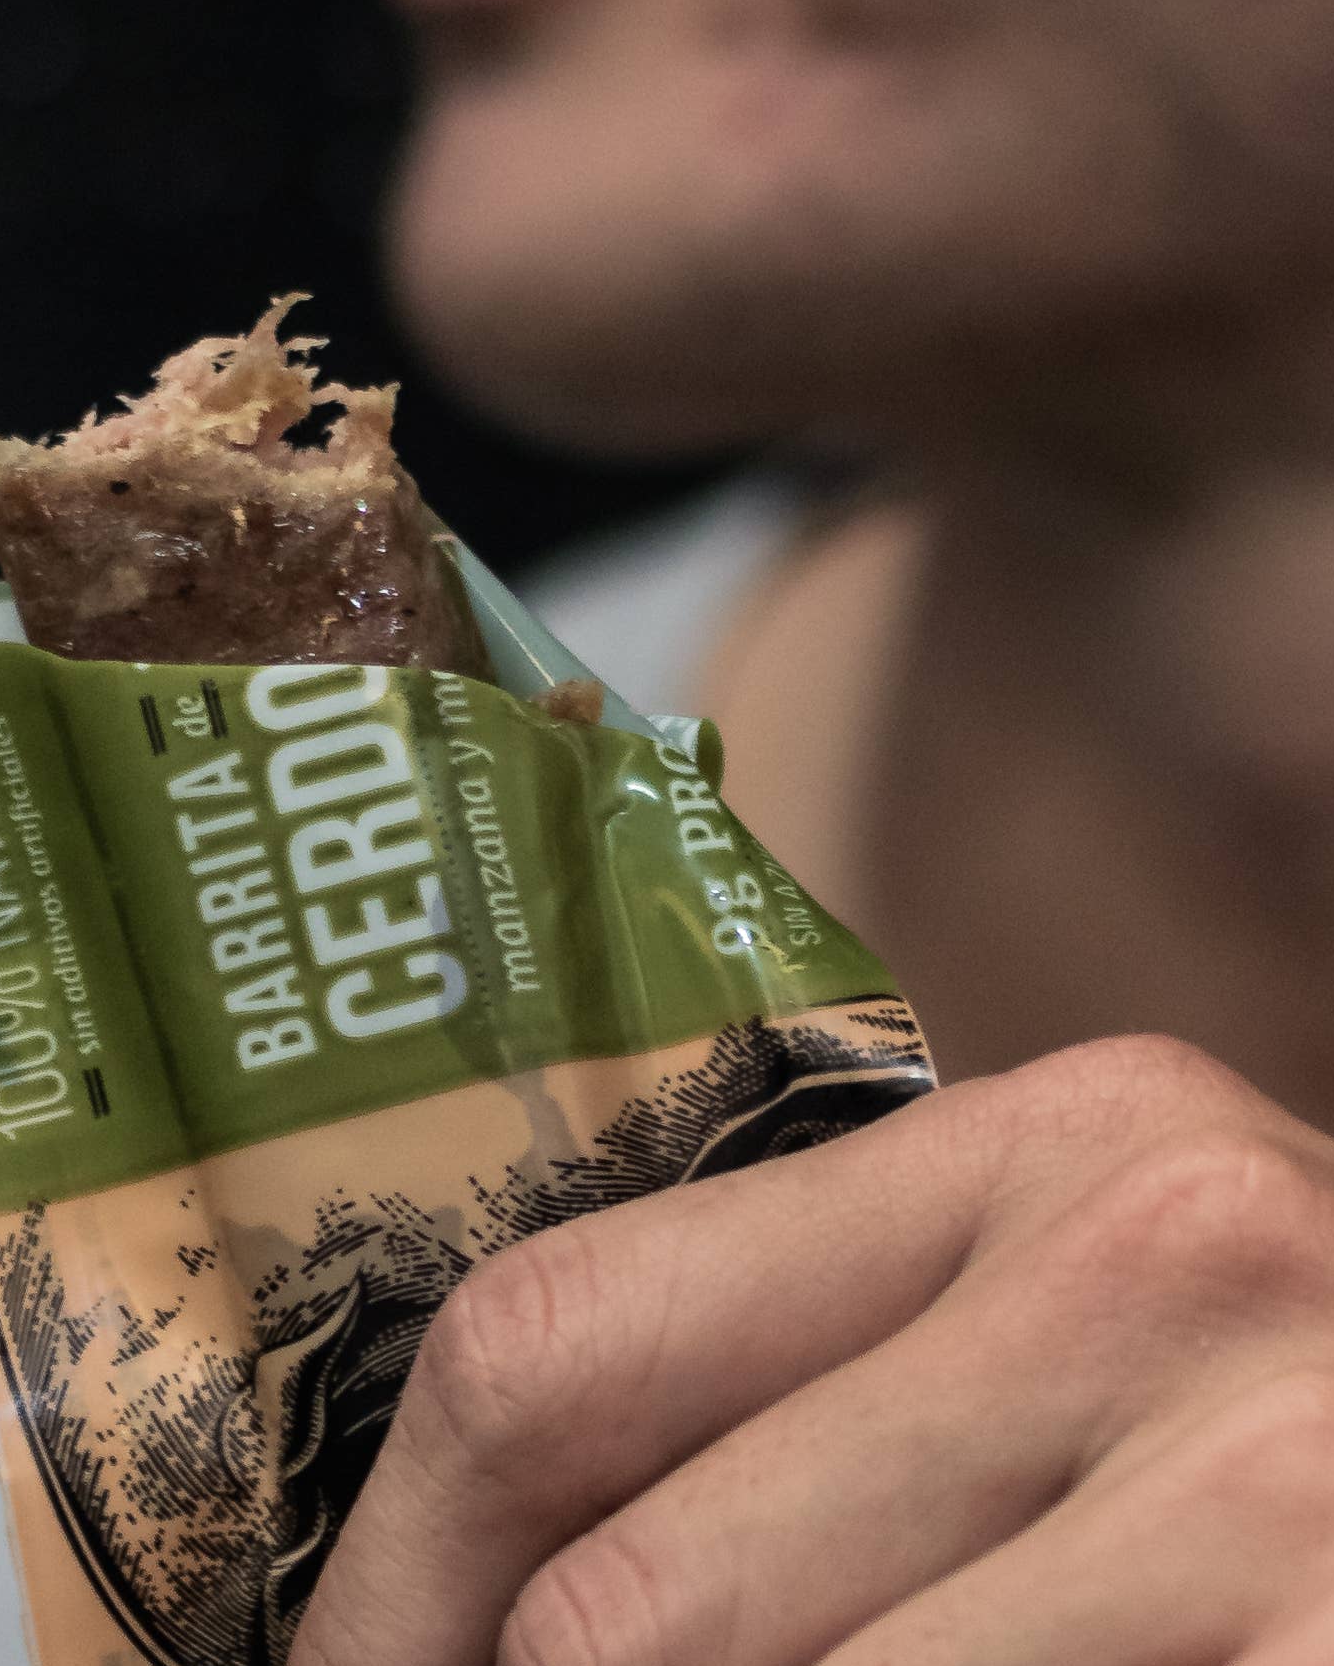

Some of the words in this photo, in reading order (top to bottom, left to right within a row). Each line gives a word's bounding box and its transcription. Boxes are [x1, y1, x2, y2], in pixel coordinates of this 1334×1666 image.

[172, 695, 213, 738] de
[449, 738, 496, 767] y
[245, 665, 468, 1039] CERDO
[457, 775, 542, 993] manzana
[40, 880, 88, 1004] aditivos
[167, 749, 321, 1072] BARRITA
[711, 871, 769, 956] 9g
[781, 905, 823, 947] SIN
[67, 1005, 103, 1056] sin
